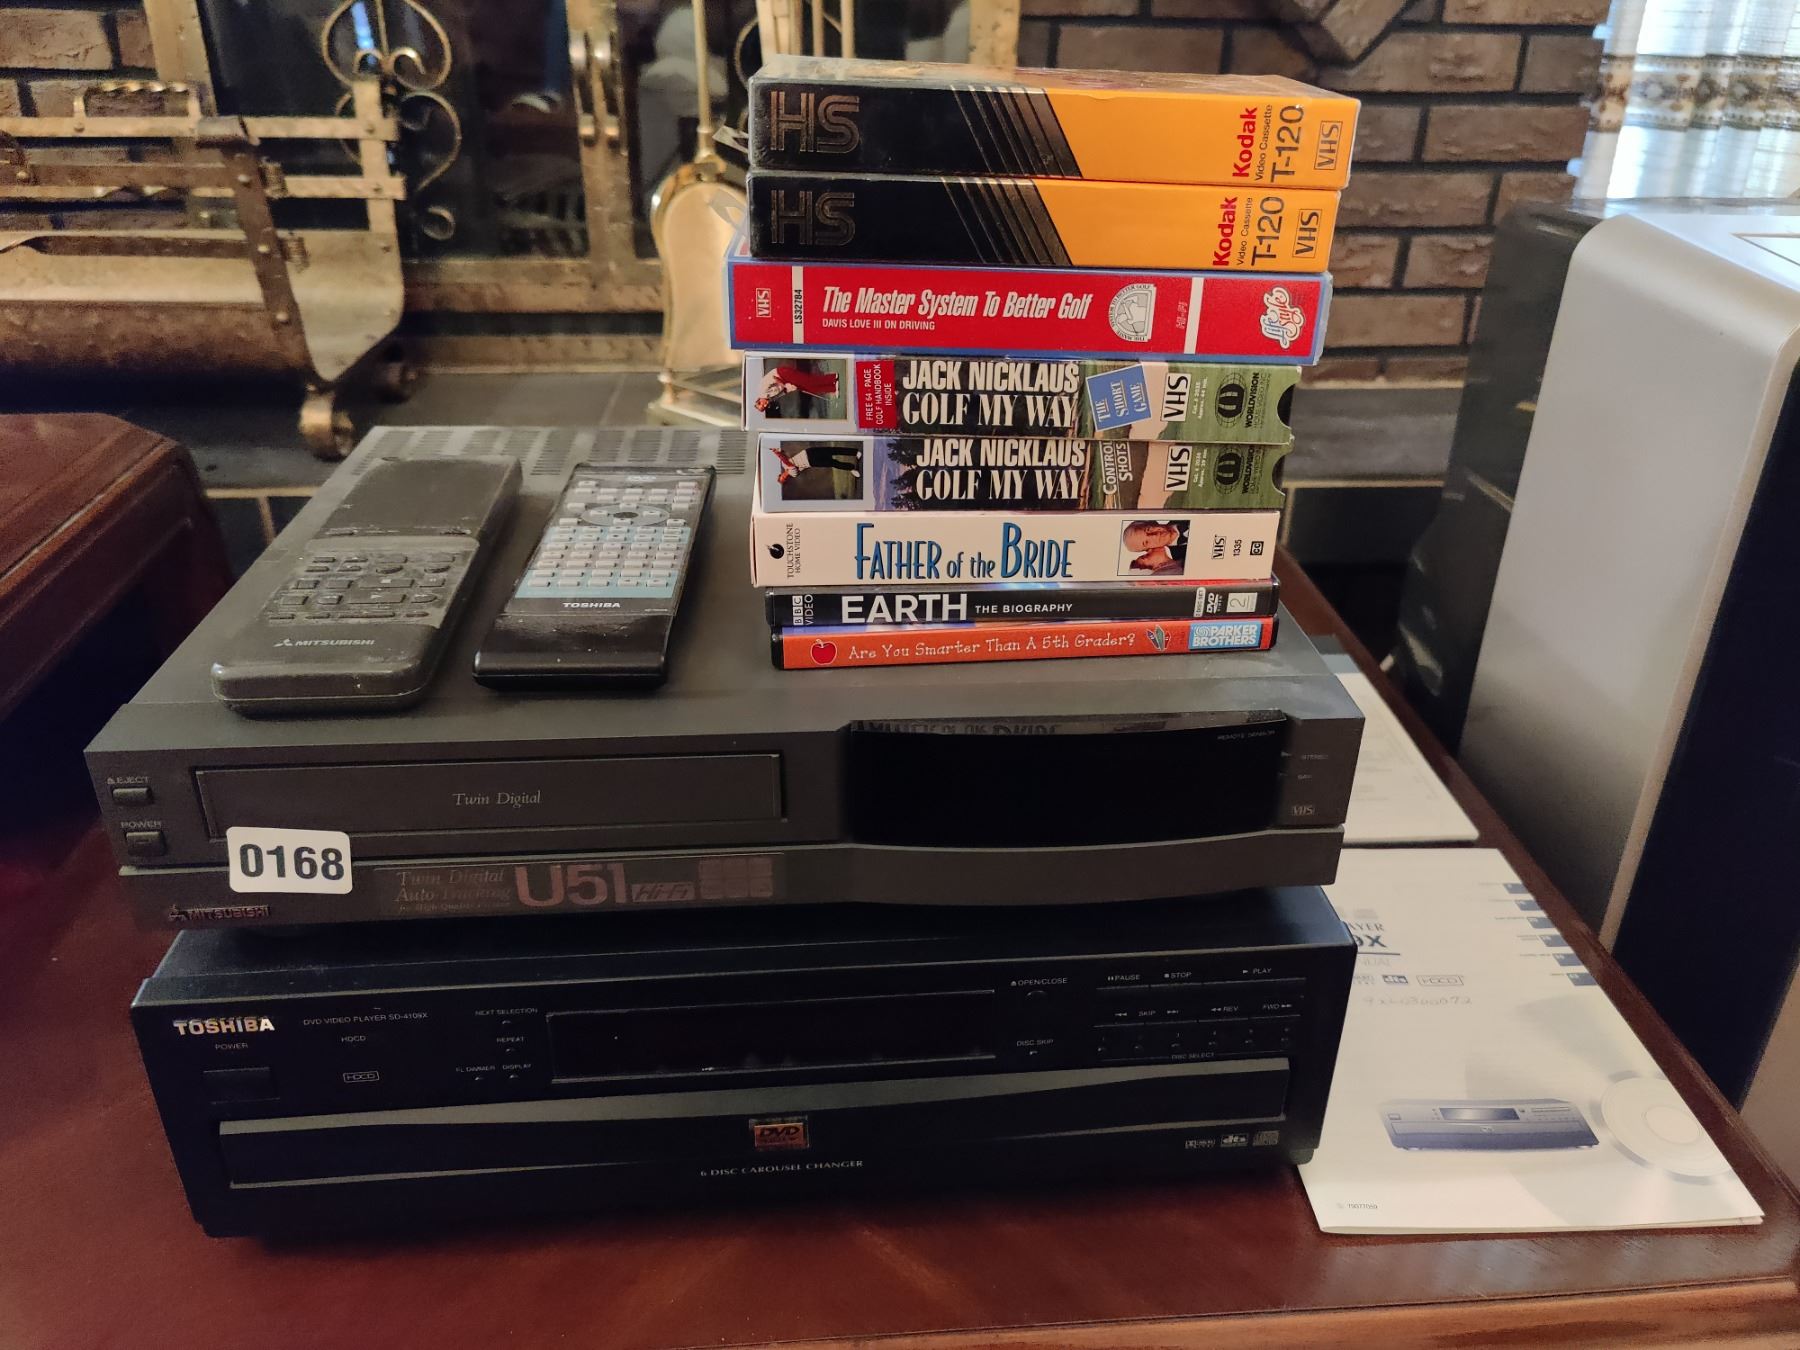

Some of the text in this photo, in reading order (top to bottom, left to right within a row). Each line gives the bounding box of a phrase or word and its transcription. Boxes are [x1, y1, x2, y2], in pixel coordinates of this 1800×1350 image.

[770, 90, 860, 153] HS
[1232, 107, 1258, 177] Kodak
[1255, 104, 1273, 181] Video Cassette
[1271, 105, 1304, 183] T-120
[1317, 123, 1340, 167] VHS
[770, 190, 856, 246] HS
[1213, 197, 1238, 266] Kodak
[1251, 196, 1284, 266] T-120
[1295, 211, 1320, 255] VHS
[1236, 239, 1248, 266] Video
[757, 289, 771, 317] VHS
[794, 289, 803, 325] LS32784
[823, 286, 1093, 319] The Master System To Better Golf
[822, 318, 935, 330] DAVIS LOVE III ON DRIVING
[864, 368, 872, 387] PAGE
[902, 360, 1079, 393] JACK NICKLAUS
[873, 364, 883, 425] GOLF HANDBOOK
[884, 383, 892, 405] INSIDE
[1111, 382, 1129, 417] SHORT
[1130, 382, 1147, 412] GAME
[1164, 375, 1188, 419] VHS
[1244, 372, 1259, 428] WORLDVISION
[865, 402, 873, 421] FREE
[902, 392, 1078, 427] GOLF MY WAY
[1095, 399, 1111, 422] THE
[916, 439, 1086, 466] JACK NICKLAUS
[1116, 443, 1133, 481] SHOTS
[1102, 441, 1118, 495] CONTROL
[1166, 447, 1191, 489] VHS
[1242, 447, 1255, 494] WORLDVISIO
[916, 470, 1086, 500] GOLF MY WAY
[855, 522, 1076, 580] FATHER of the BRIDE
[1213, 537, 1225, 558] VHS
[1233, 540, 1242, 557] 1335
[794, 596, 803, 625] BBC
[804, 594, 814, 625] VIDEO
[842, 593, 968, 624] EARTH
[975, 604, 1073, 614] THE BIOGRAPHY
[1206, 593, 1215, 613] DVD
[1192, 635, 1256, 647] BROTHERS
[1211, 624, 1258, 636] PARKER
[849, 633, 1136, 660] Are You Smarter Than A 5th Grader?
[453, 790, 541, 808] Twin Digital
[120, 820, 162, 829] POWER
[239, 843, 345, 880] 0168
[448, 870, 505, 884] Digital
[514, 863, 627, 907] U51
[396, 888, 434, 902] Auto
[188, 906, 269, 920] MITSUBISHI
[1170, 971, 1192, 979] STOP
[173, 1018, 276, 1035] TOSHIBA
[303, 1018, 323, 1026] DVD
[353, 1014, 387, 1023] PLAYER
[215, 1042, 249, 1050] POWER
[760, 1126, 800, 1136] DVD
[710, 1167, 738, 1176] DISC
[741, 1164, 802, 1174] CAROUSEL
[805, 1160, 864, 1170] CHANGER
